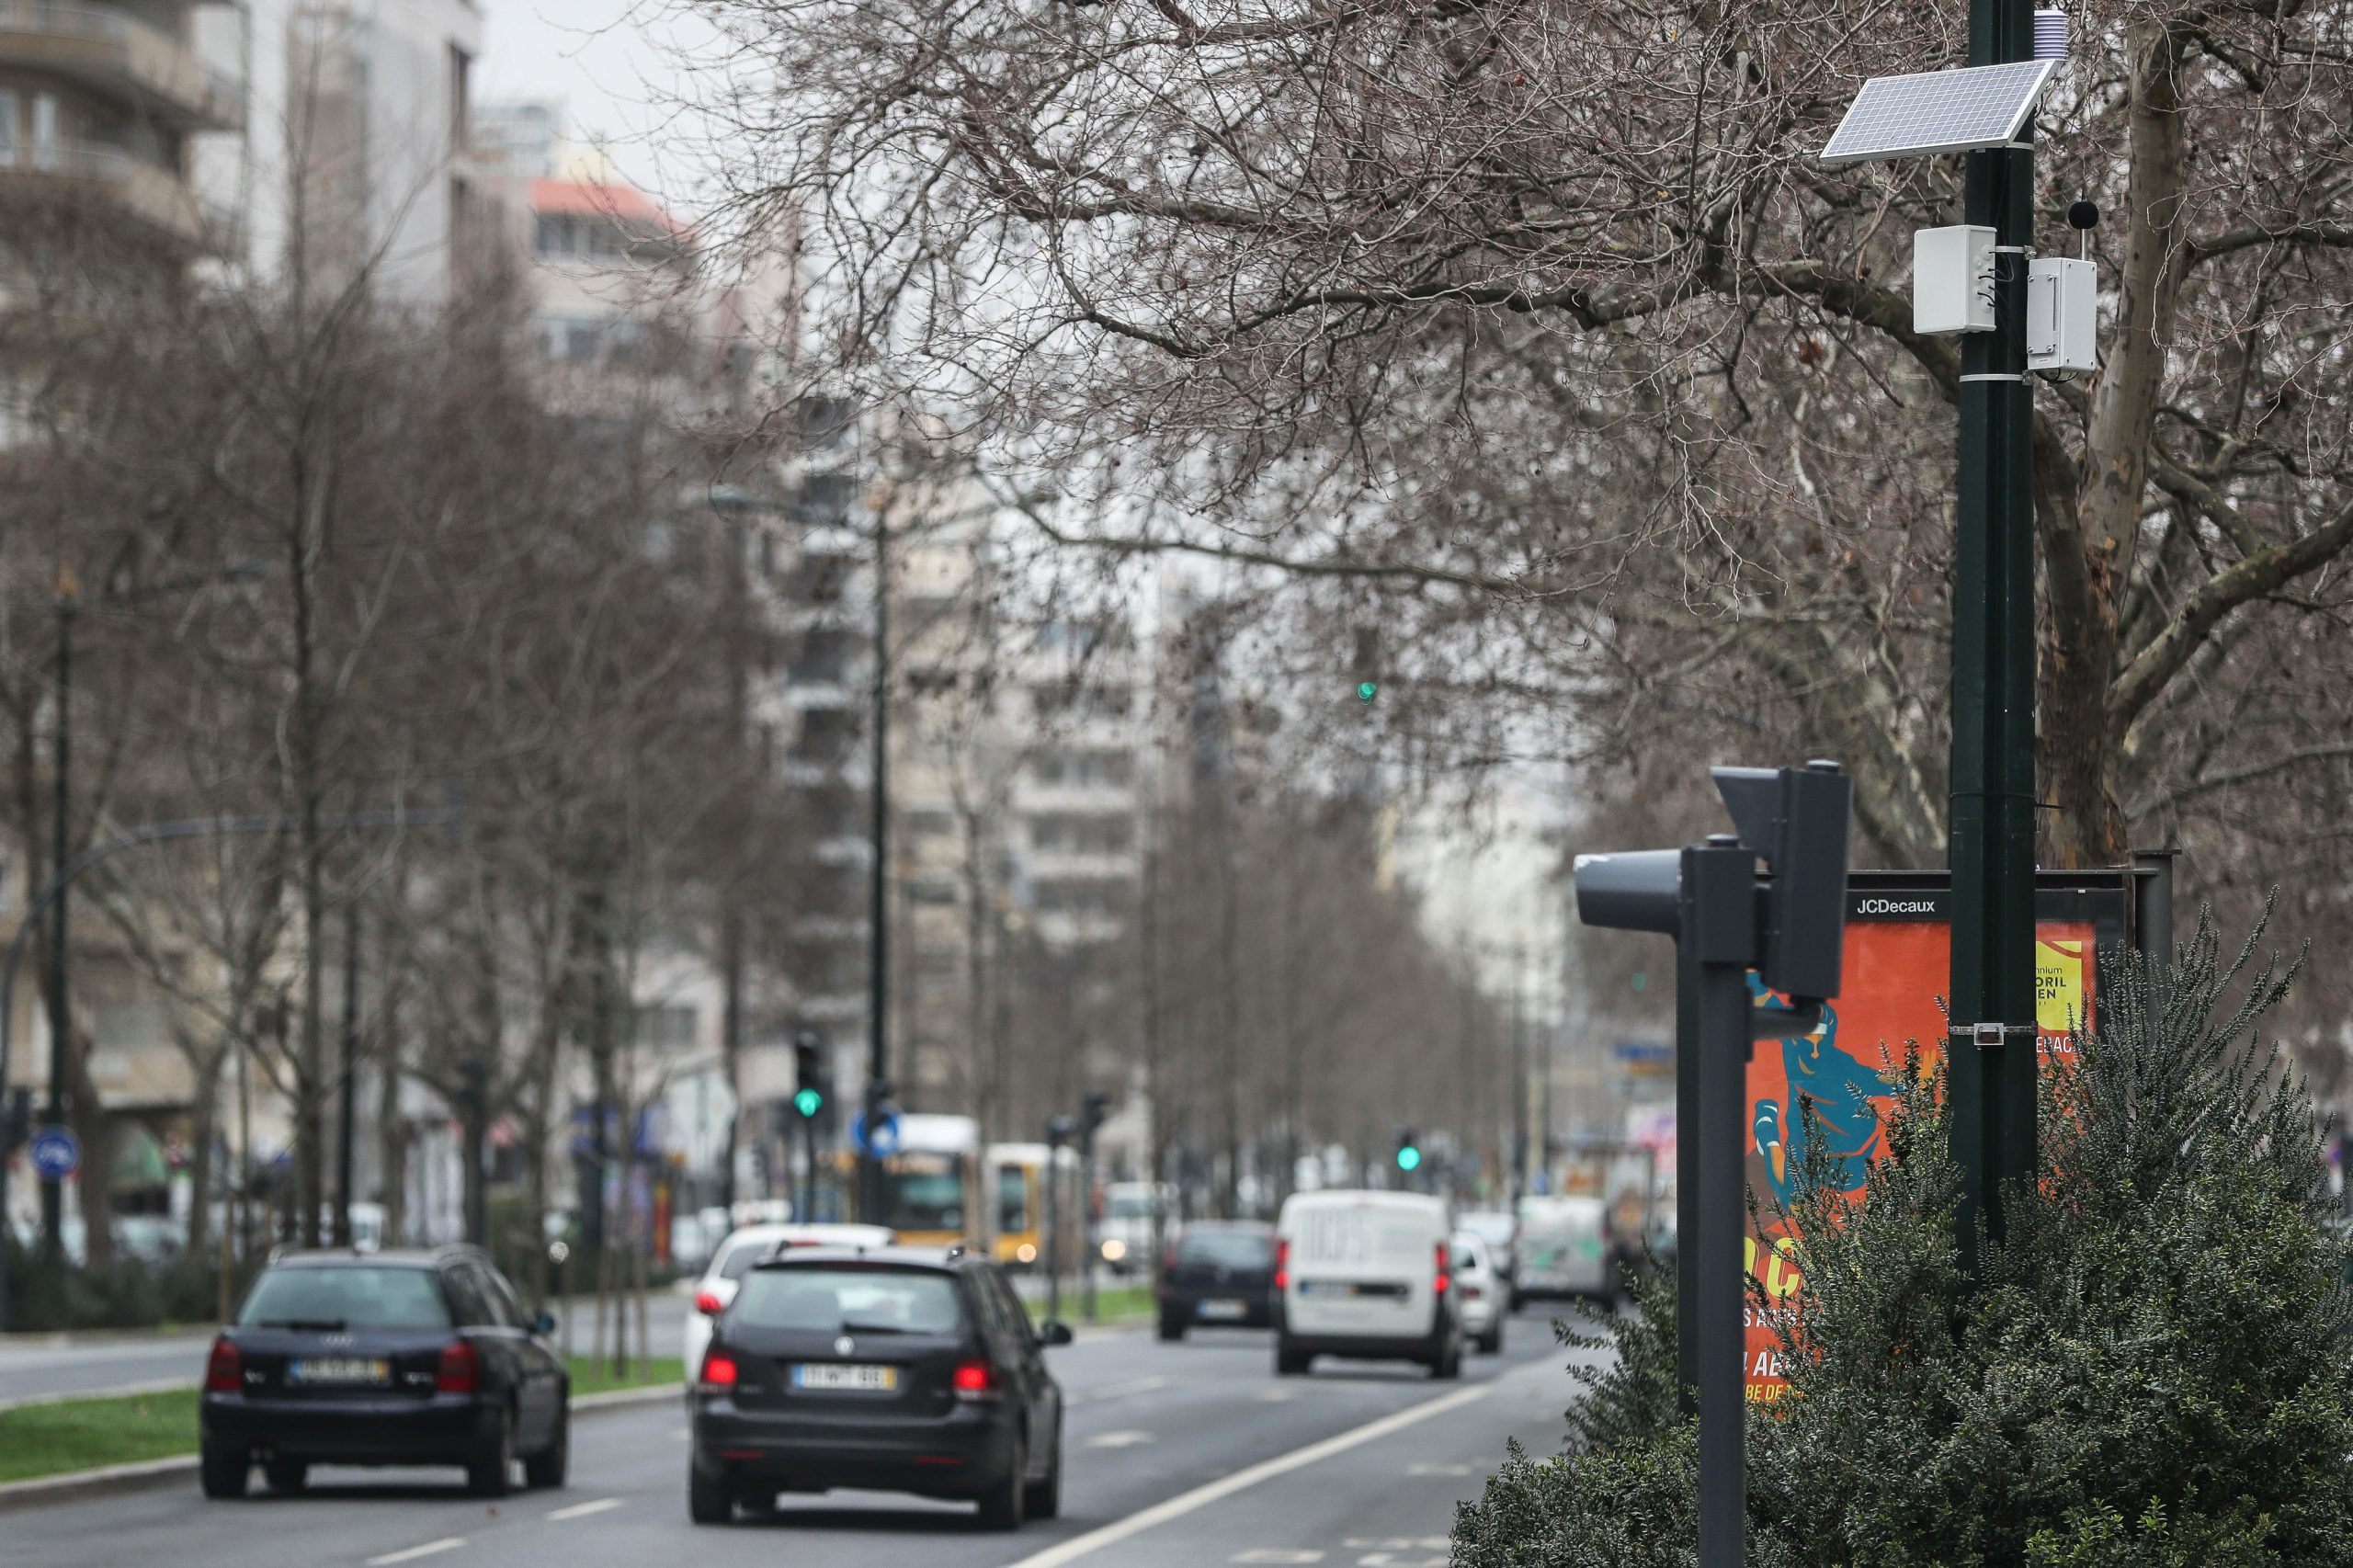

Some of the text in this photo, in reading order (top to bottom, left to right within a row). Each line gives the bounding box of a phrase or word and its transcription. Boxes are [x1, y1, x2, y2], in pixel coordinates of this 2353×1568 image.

[1857, 899, 1935, 914] JCDecaux
[2035, 976, 2066, 987] ORIL
[2038, 988, 2056, 999] EN
[1745, 1383, 1763, 1400] BE
